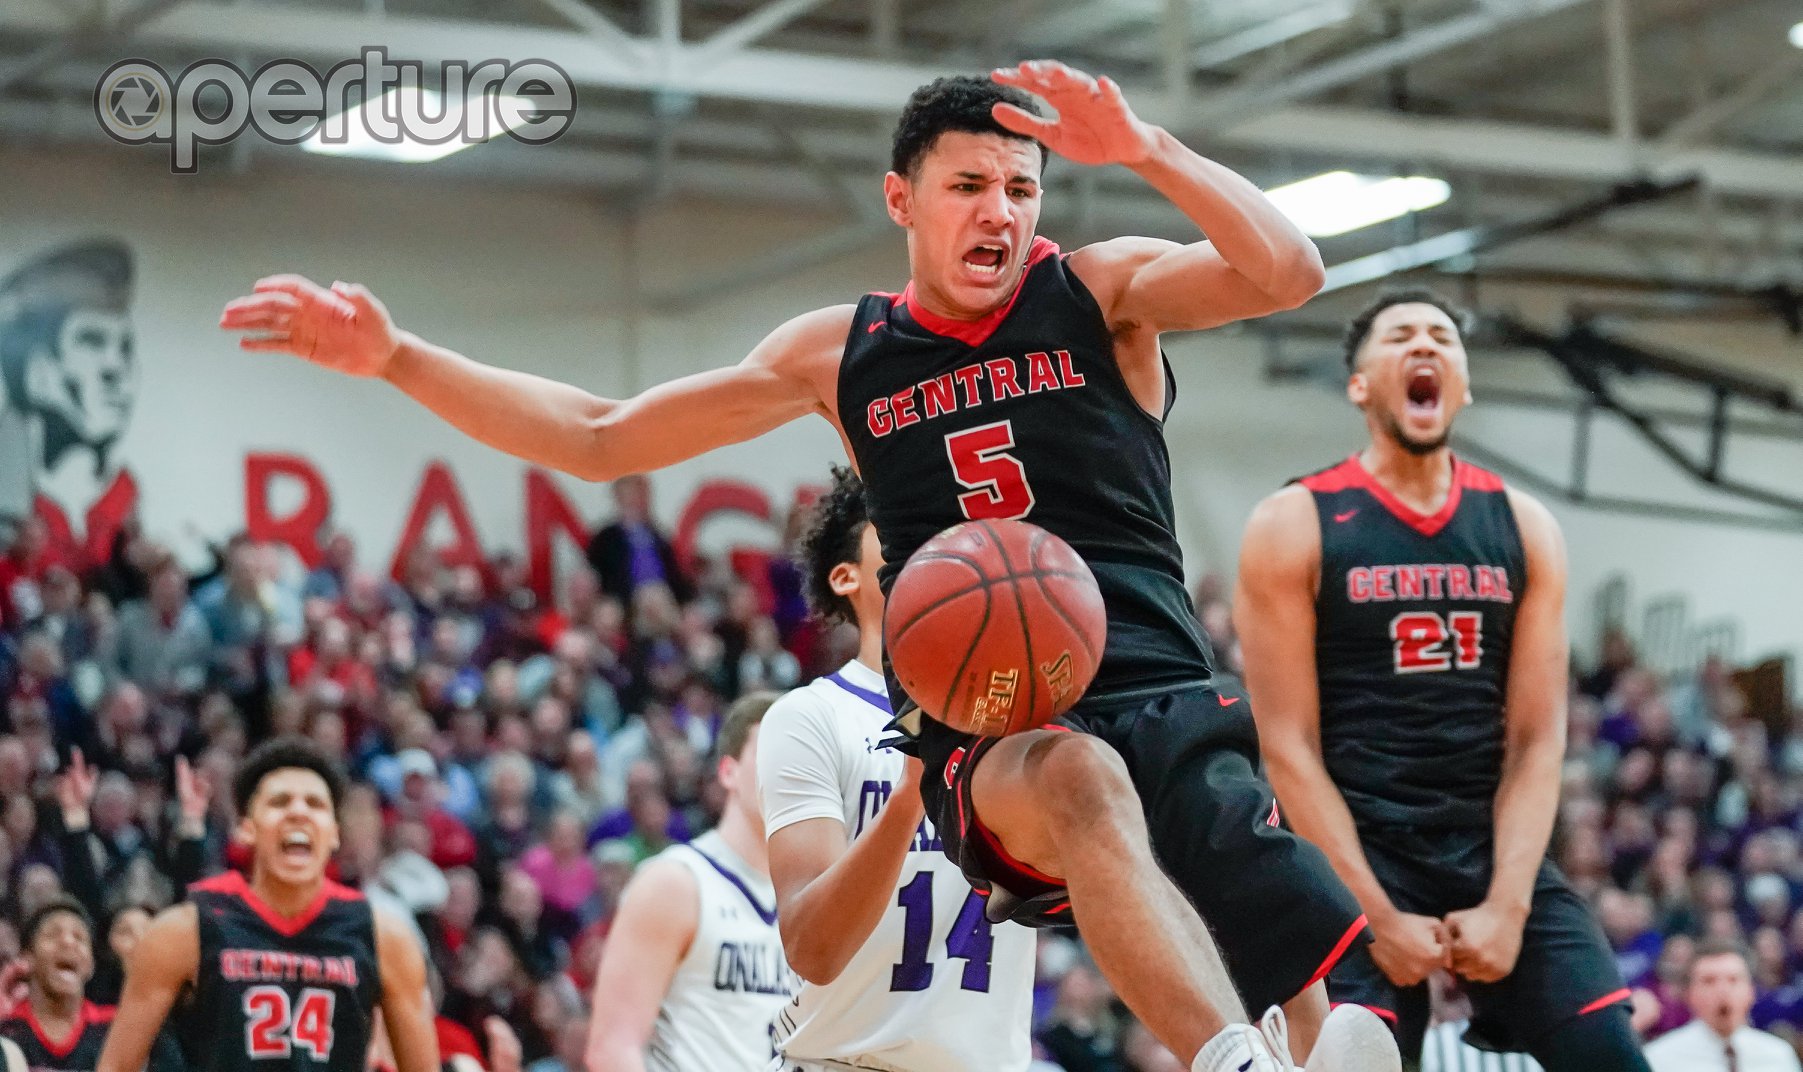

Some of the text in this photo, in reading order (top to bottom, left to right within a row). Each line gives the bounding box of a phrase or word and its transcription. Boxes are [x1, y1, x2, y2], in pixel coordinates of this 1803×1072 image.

[867, 350, 1086, 438] CENTRAL
[944, 419, 1036, 521] 5
[244, 452, 830, 606] RANG
[1347, 563, 1514, 604] CENTRAL
[1390, 611, 1484, 675] 21
[219, 949, 359, 987] CENTRAL
[889, 870, 995, 993] 14
[242, 984, 336, 1064] 24
